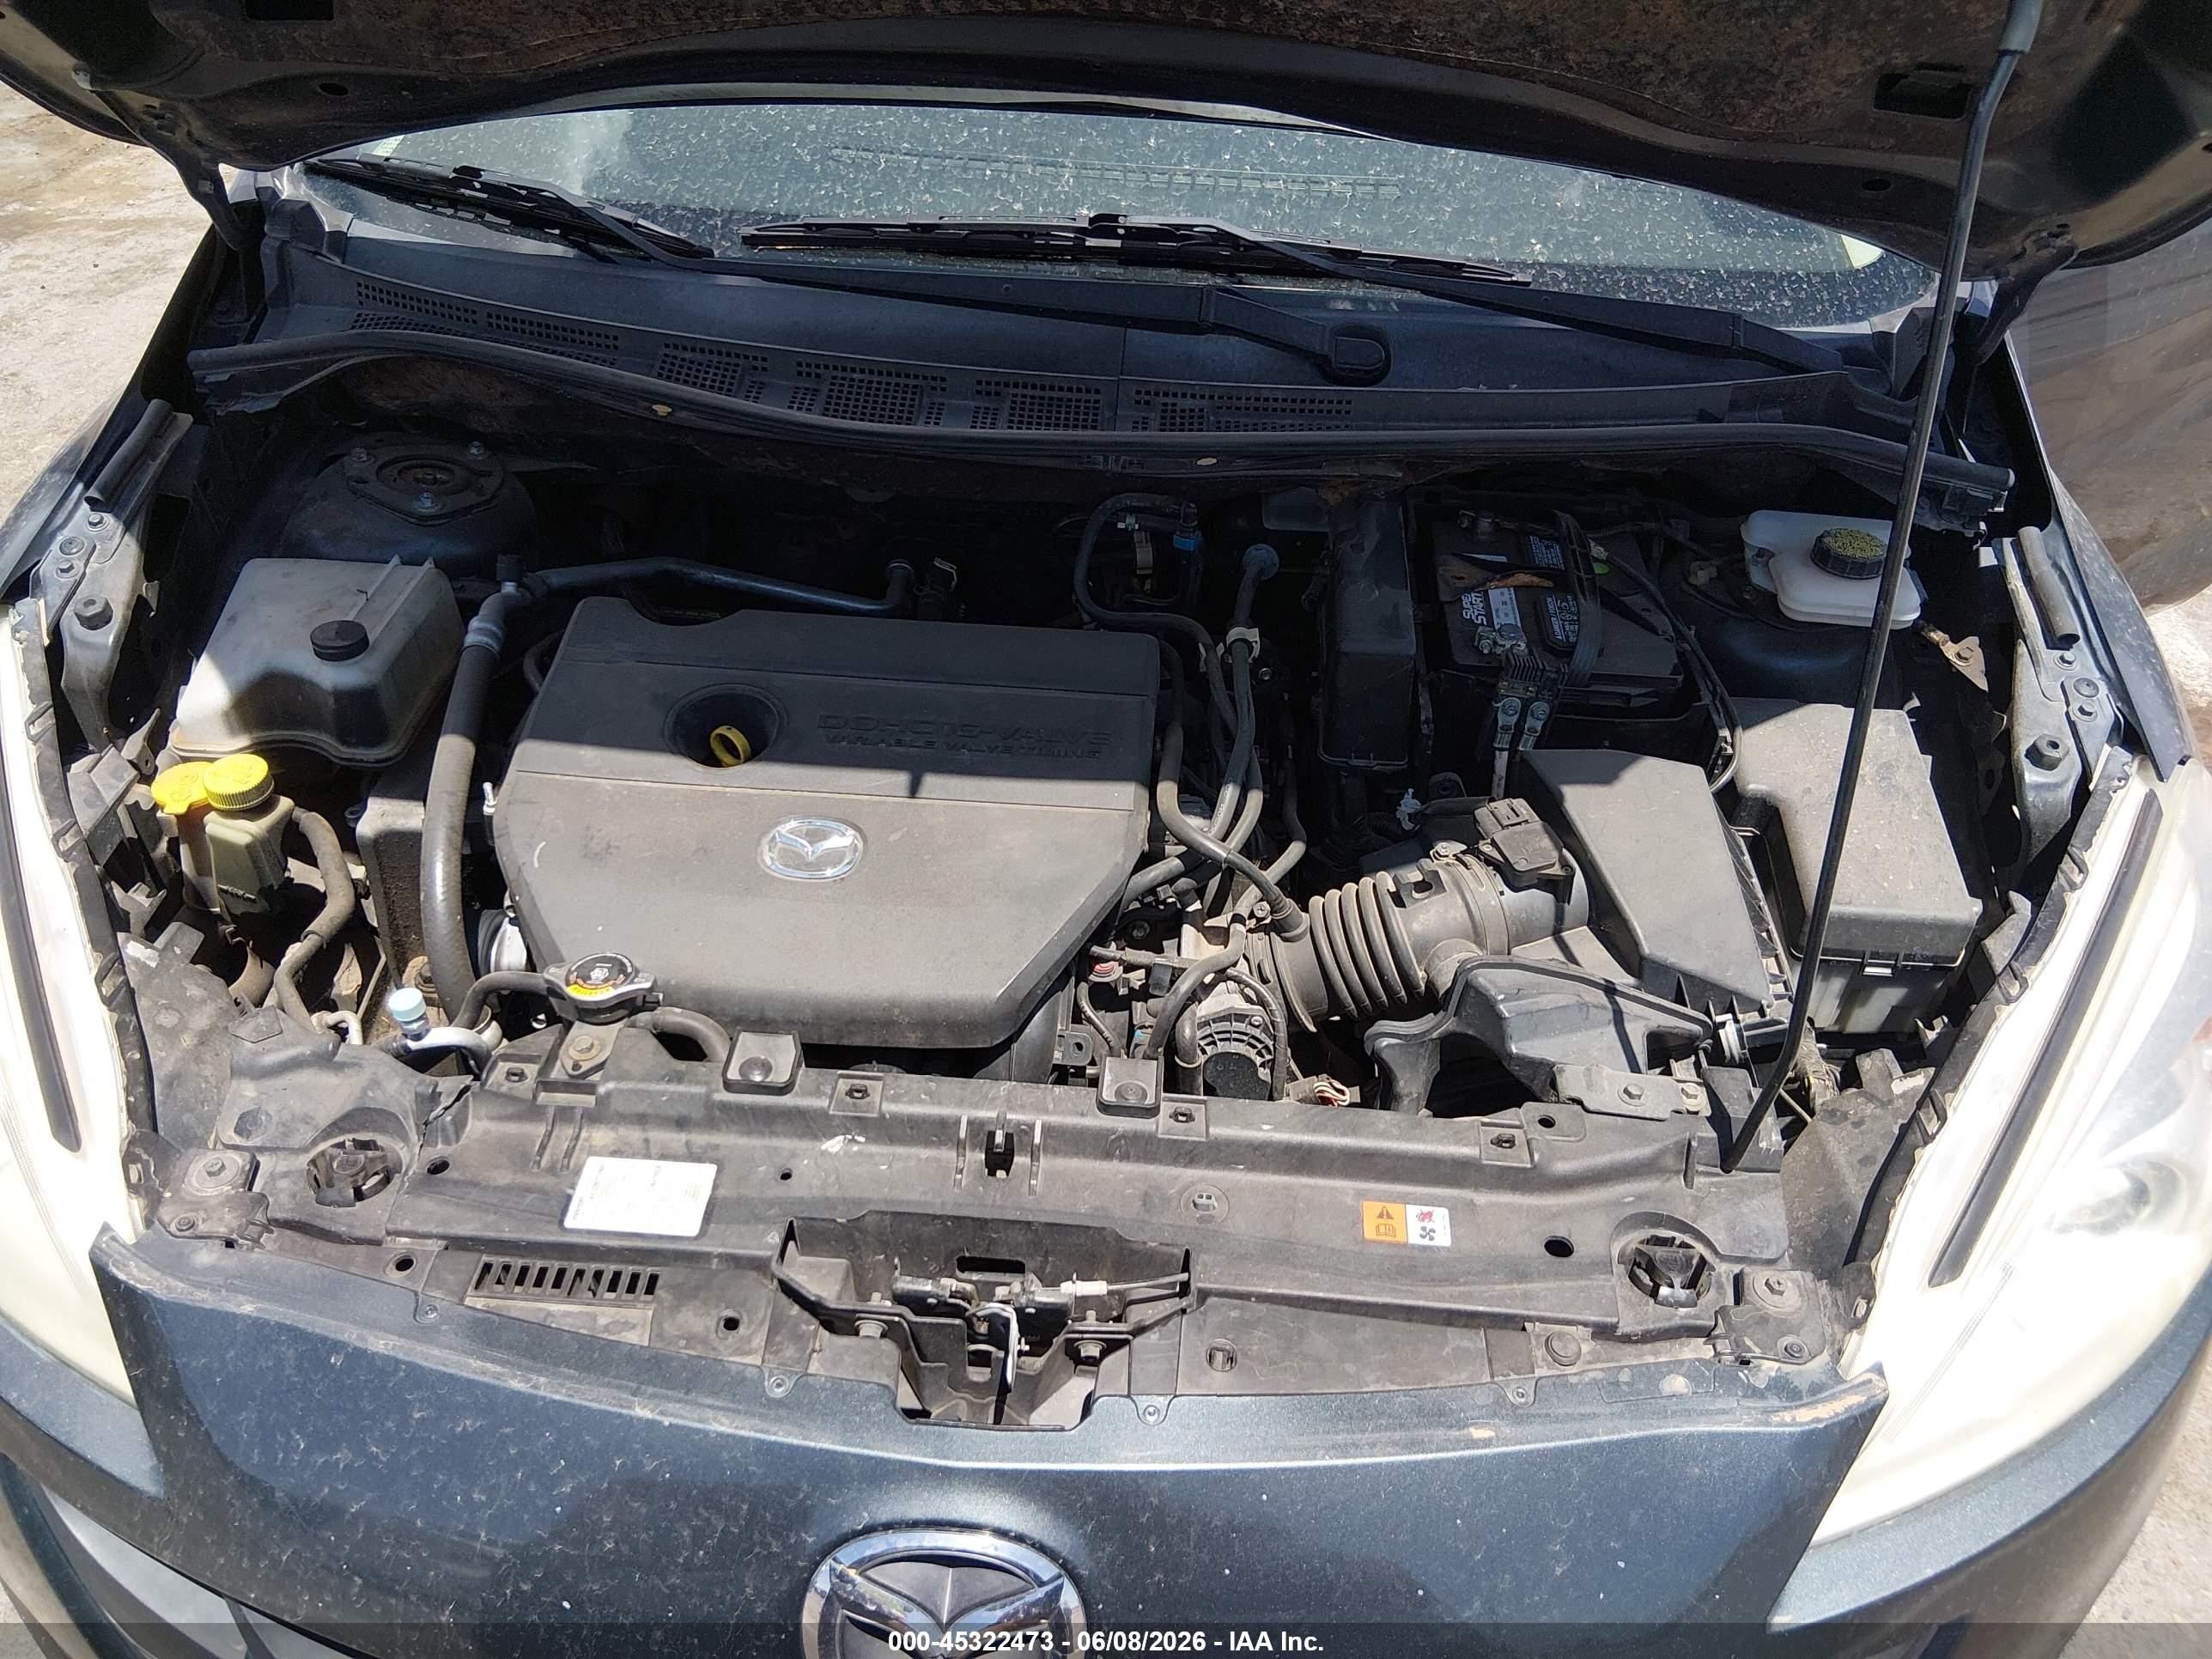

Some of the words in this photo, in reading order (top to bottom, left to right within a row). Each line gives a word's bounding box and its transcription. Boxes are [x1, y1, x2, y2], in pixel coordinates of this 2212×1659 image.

[1462, 592, 1474, 619] SUPE
[1471, 592, 1487, 626] START
[1546, 597, 1555, 613] POISON
[1551, 617, 1561, 635] DANGER
[817, 714, 935, 735] DOHC
[824, 733, 937, 750] VARIABLE
[943, 740, 1014, 755] VALVE
[1018, 746, 1101, 760] TIMING
